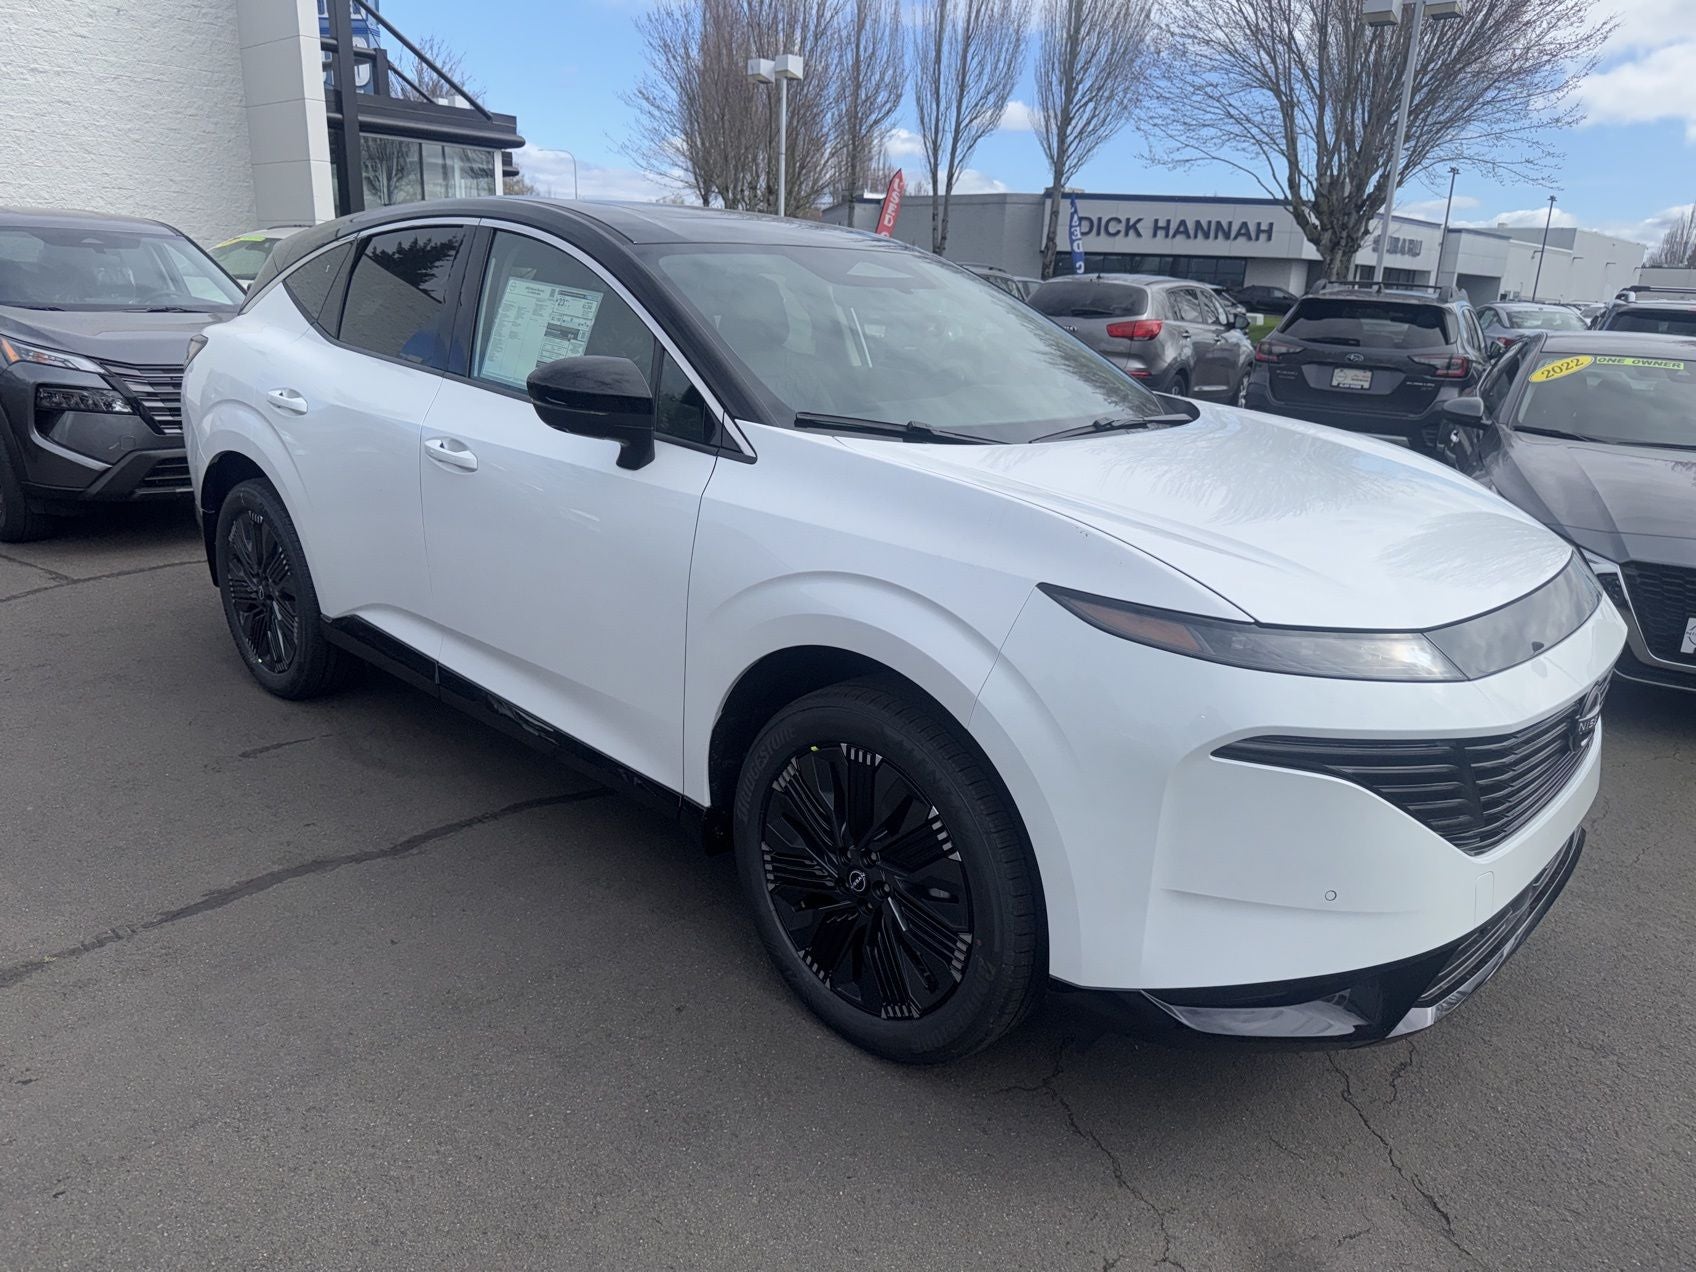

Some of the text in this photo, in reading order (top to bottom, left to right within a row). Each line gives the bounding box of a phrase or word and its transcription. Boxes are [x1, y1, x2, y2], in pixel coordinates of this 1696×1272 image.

[1080, 216, 1274, 242] DICK HANNAH
[1541, 358, 1583, 379] 2022
[1632, 359, 1681, 369] OWNER
